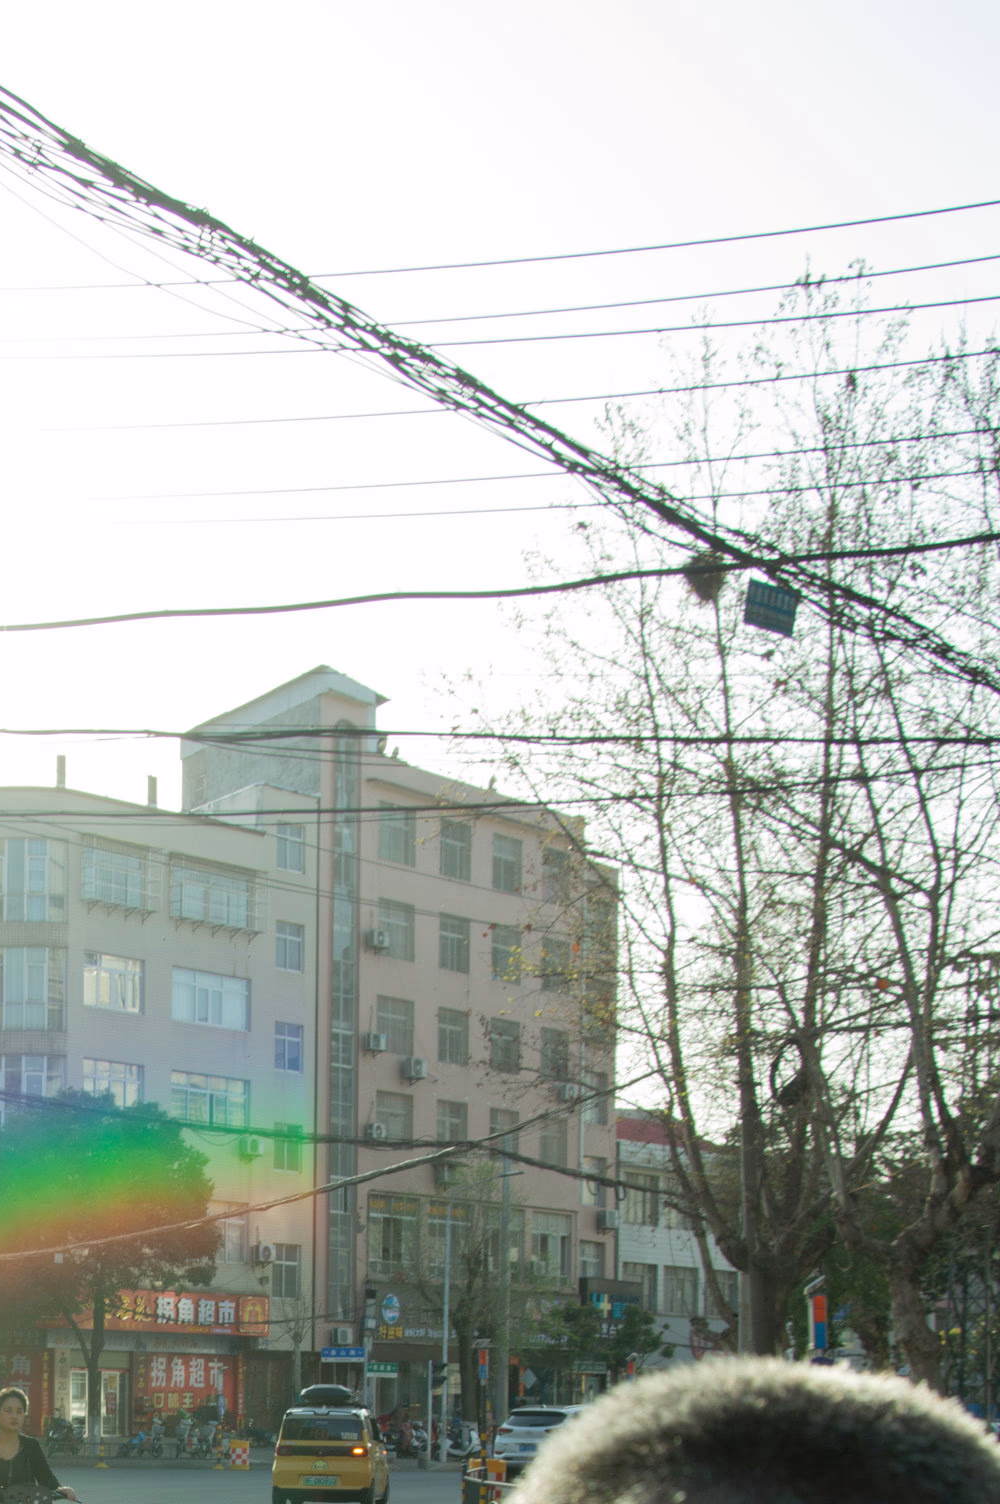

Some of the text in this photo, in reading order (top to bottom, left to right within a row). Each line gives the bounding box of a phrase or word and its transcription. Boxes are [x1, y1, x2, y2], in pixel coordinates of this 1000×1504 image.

[156, 1296, 236, 1327] 拐角超市
[151, 1355, 224, 1388] 拐角超市
